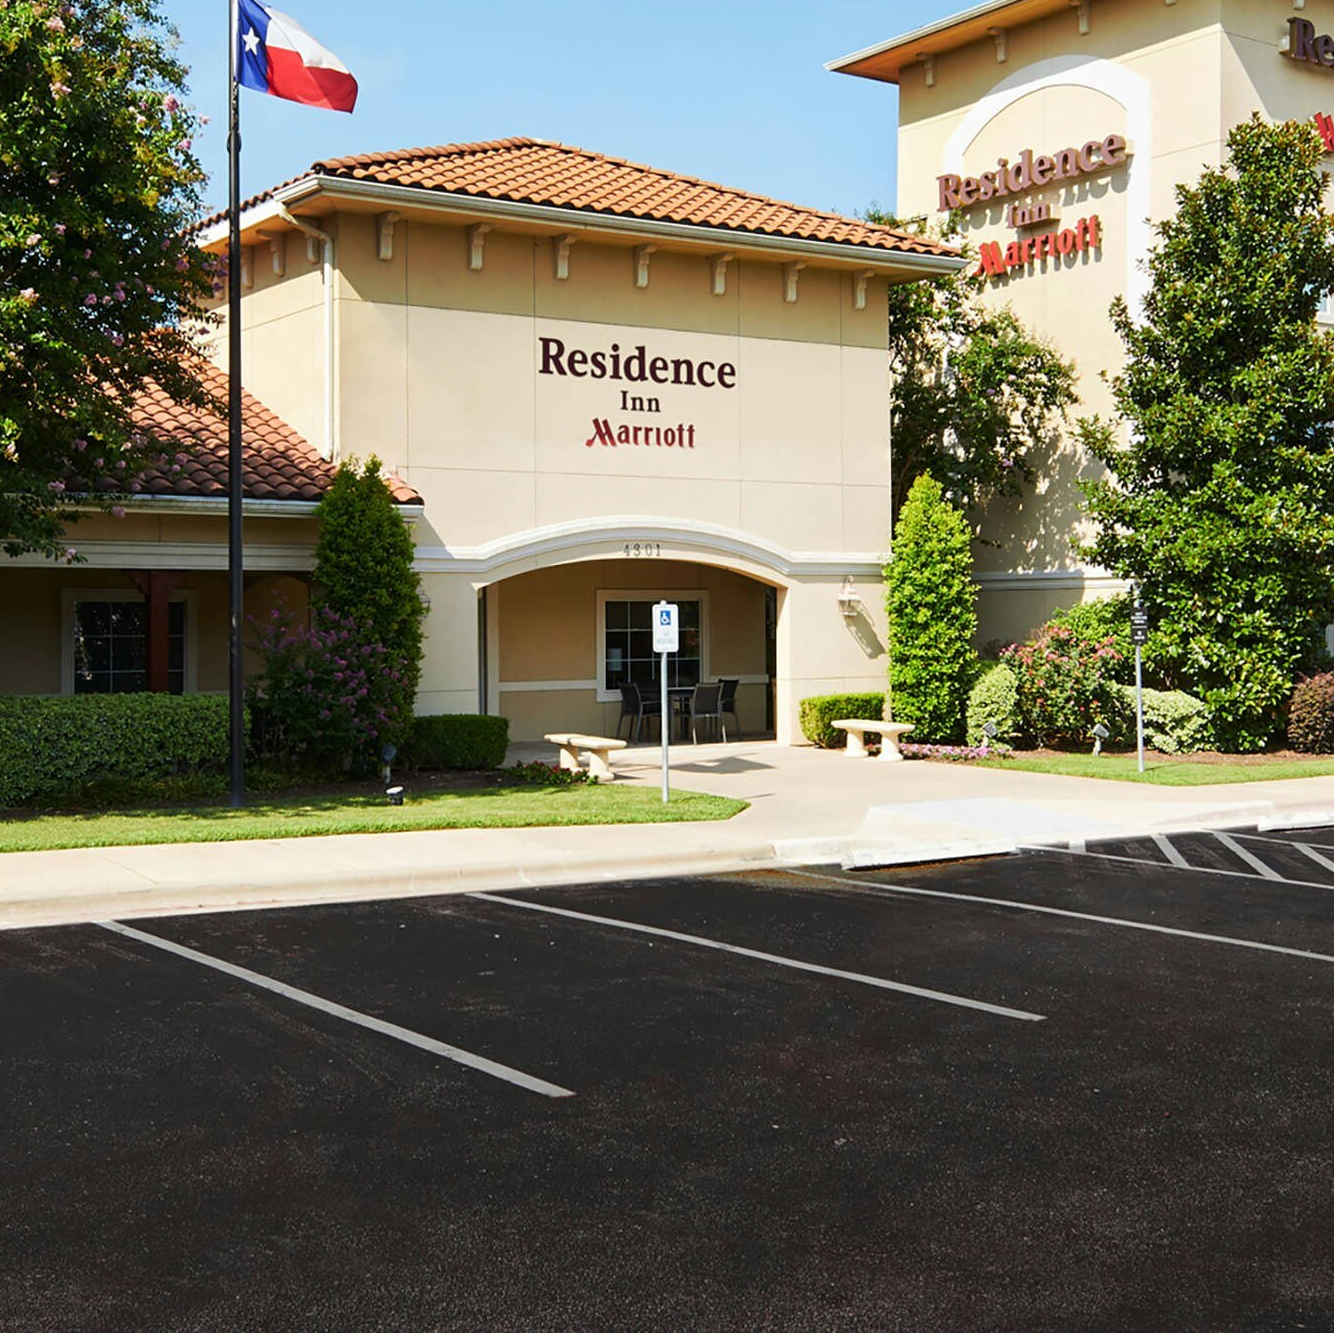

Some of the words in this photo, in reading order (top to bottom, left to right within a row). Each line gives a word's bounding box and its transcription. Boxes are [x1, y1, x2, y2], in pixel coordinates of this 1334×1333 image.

[936, 134, 1127, 212] Residence
[1006, 202, 1051, 229] Inn
[971, 214, 1101, 277] Marriott
[538, 337, 736, 389] Residence
[620, 390, 661, 412] Inn
[585, 417, 696, 448] Marriott
